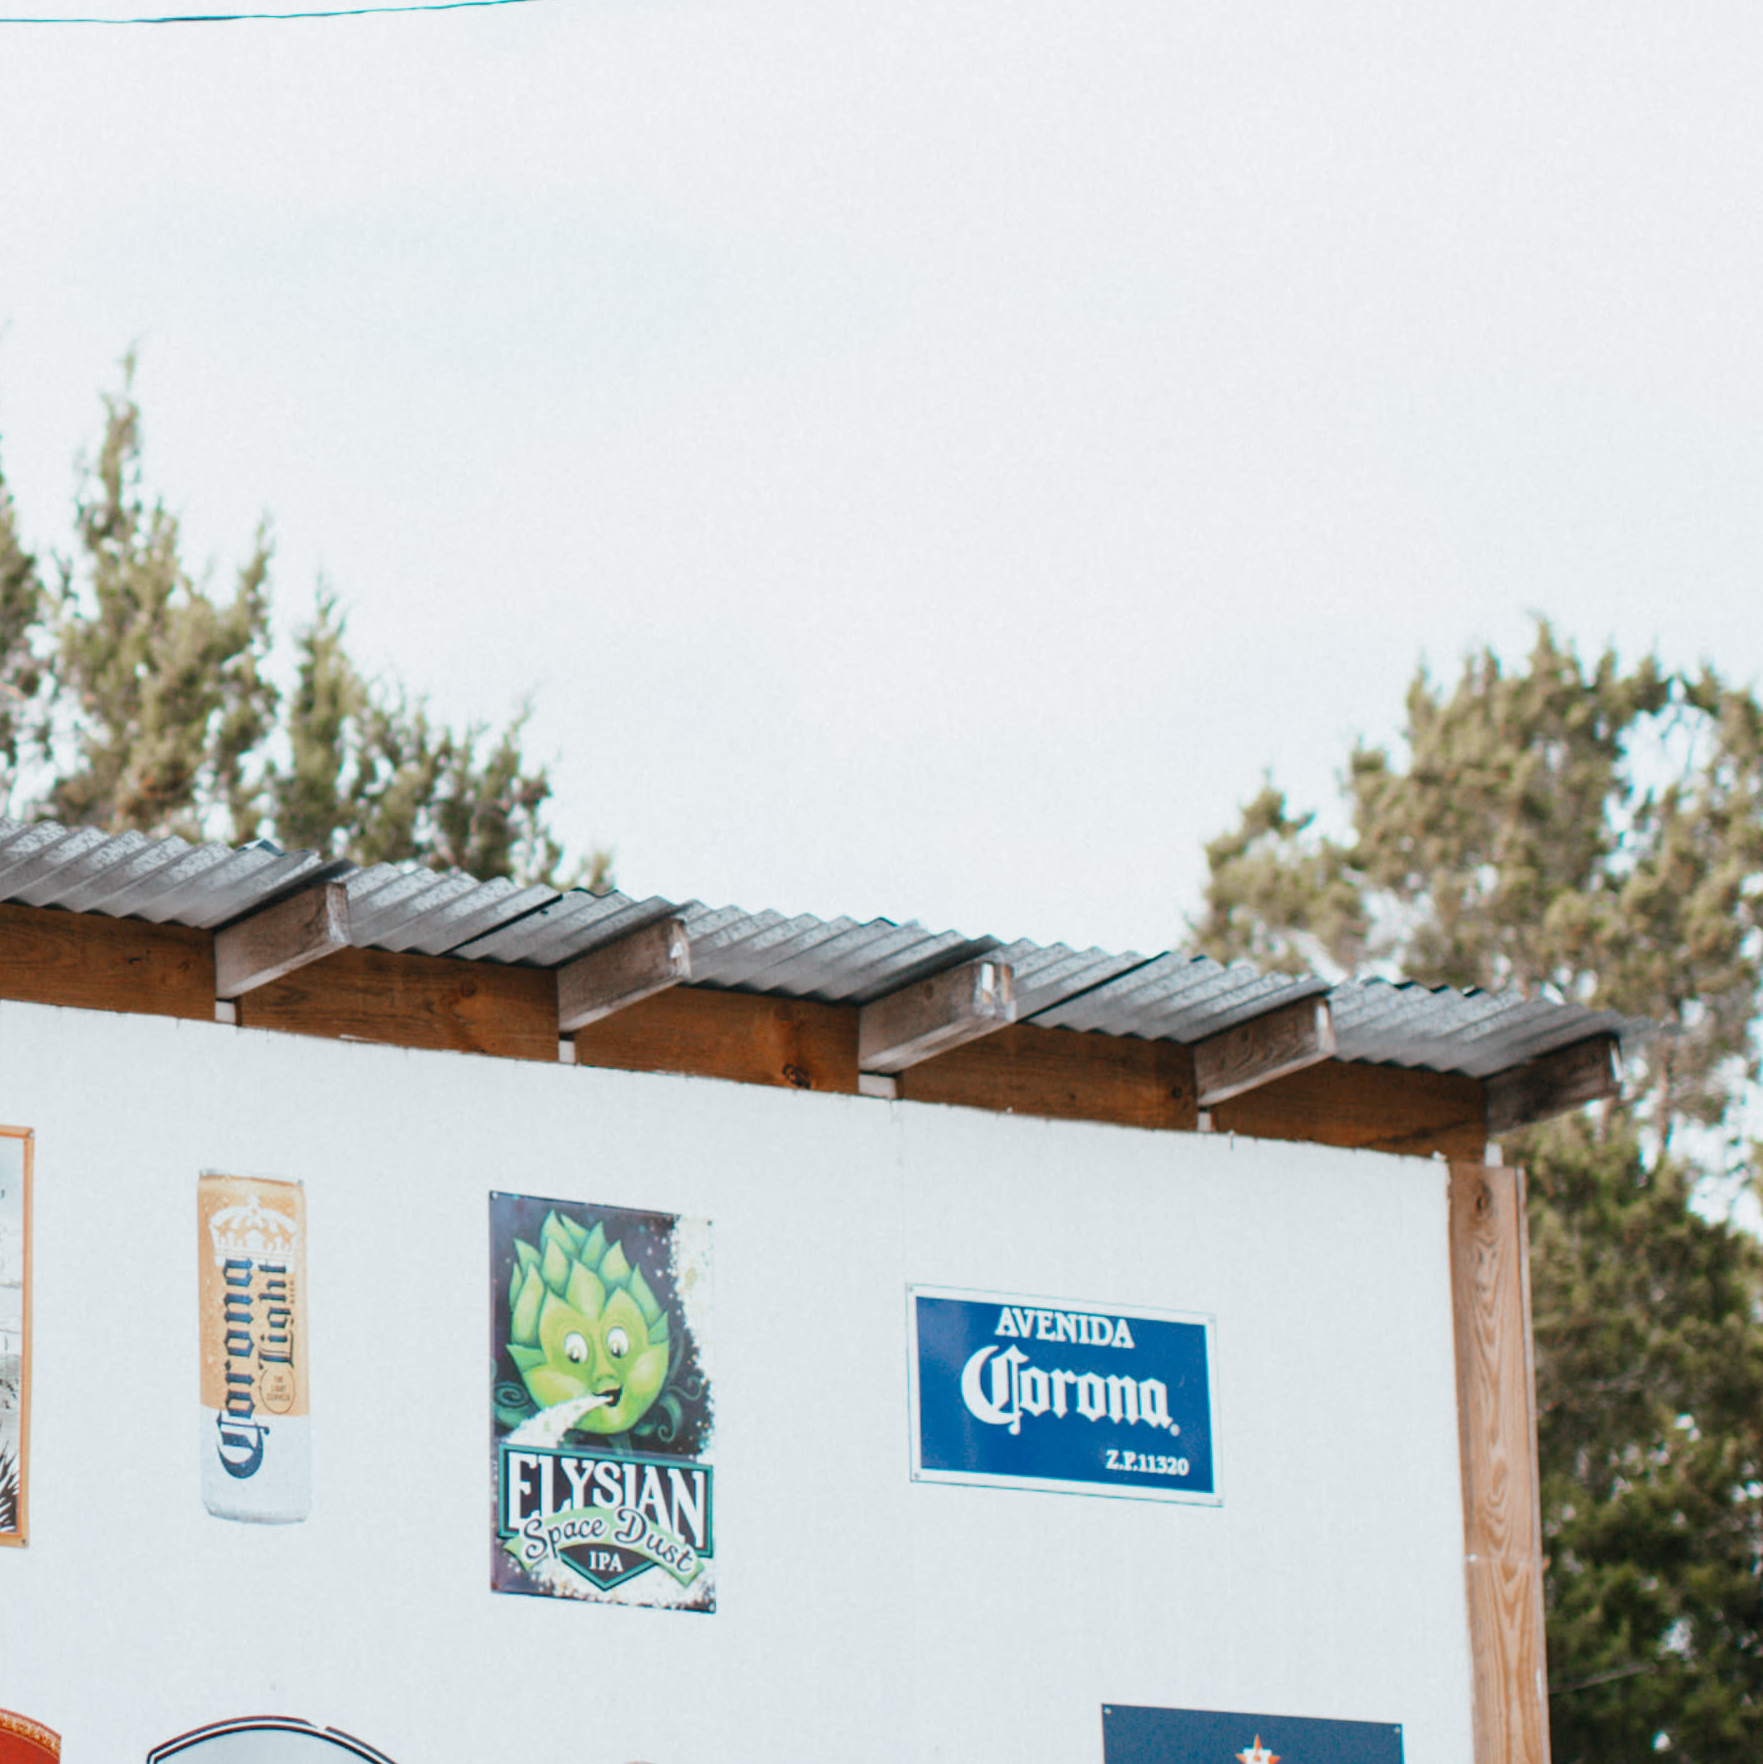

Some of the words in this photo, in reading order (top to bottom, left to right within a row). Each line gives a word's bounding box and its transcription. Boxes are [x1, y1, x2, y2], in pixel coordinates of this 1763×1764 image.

[258, 1264, 294, 1370] Light
[994, 1307, 1135, 1348] AVENIDA
[216, 1258, 270, 1479] Corona
[508, 1450, 705, 1549] ELYSIAN
[523, 1518, 606, 1560] Space
[614, 1508, 695, 1572] Dust
[589, 1551, 624, 1572] IPA
